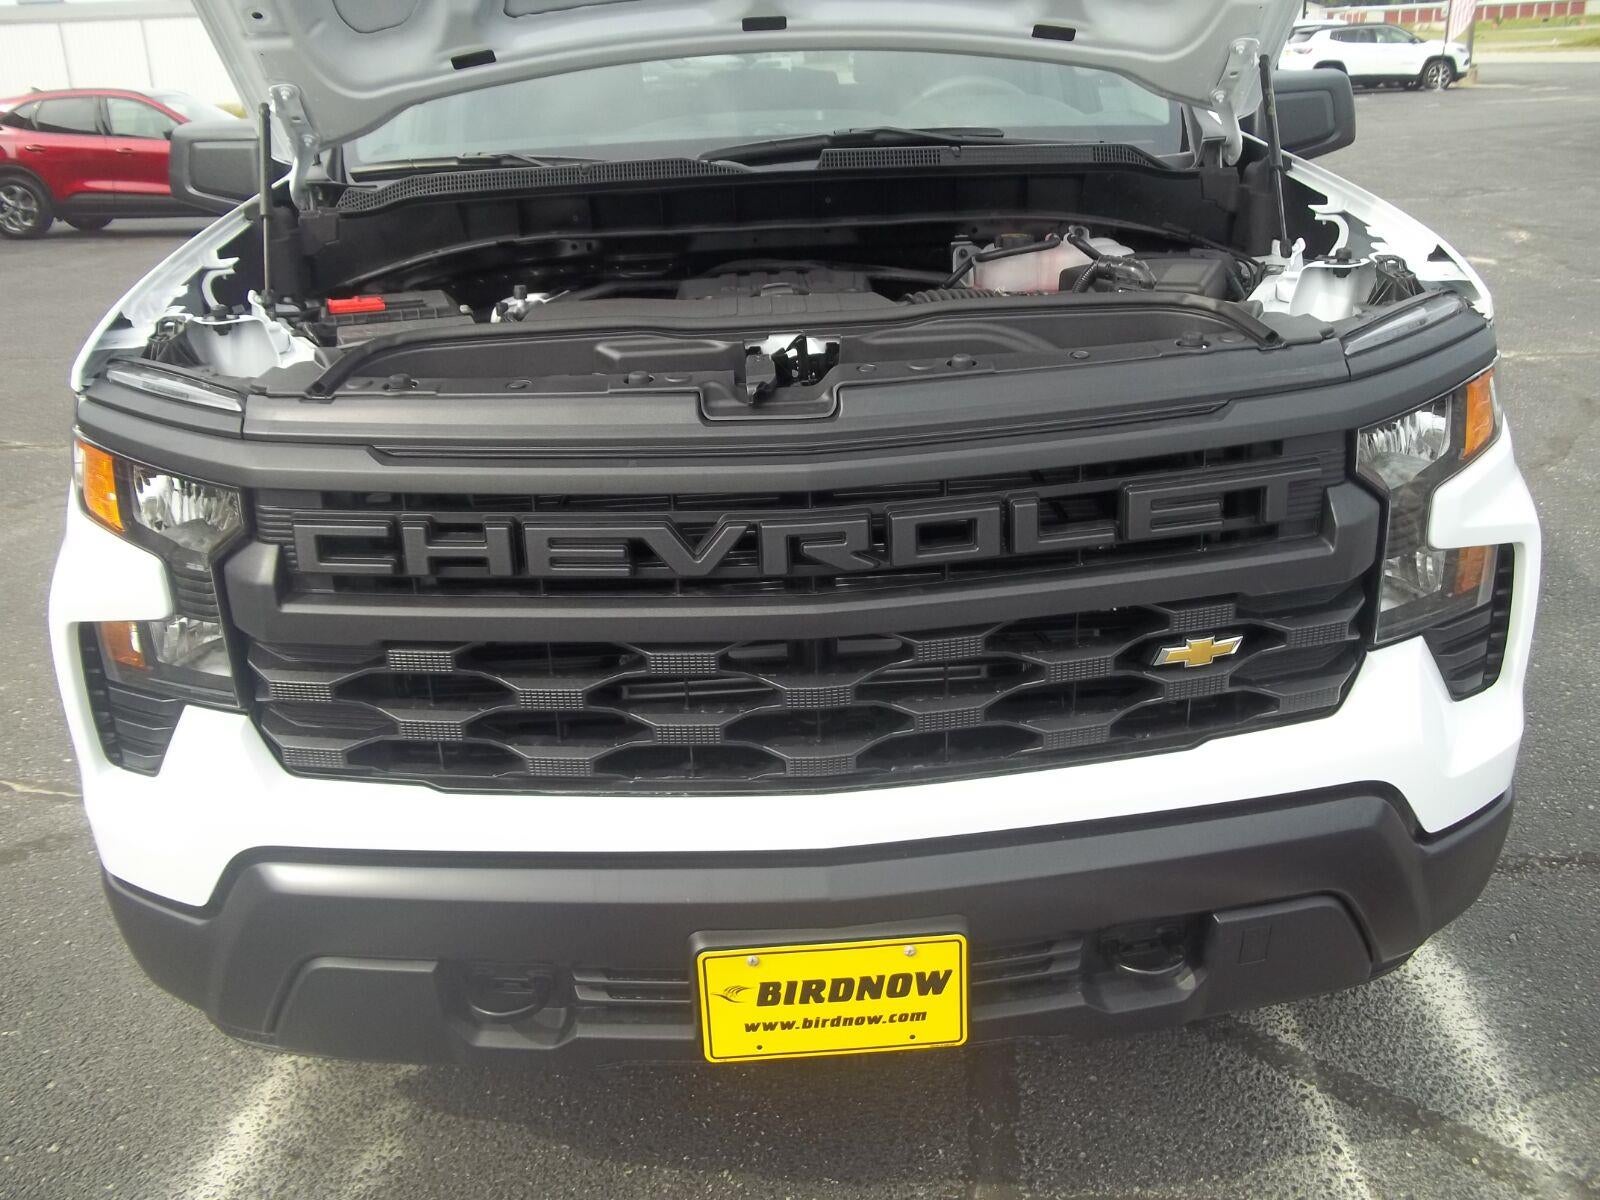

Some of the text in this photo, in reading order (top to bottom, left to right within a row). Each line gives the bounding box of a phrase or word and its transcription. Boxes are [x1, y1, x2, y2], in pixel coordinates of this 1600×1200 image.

[293, 465, 1322, 577] CHEVROLET
[756, 969, 953, 1007] BIRDNOW
[744, 1011, 927, 1032] www.birdnow.com
